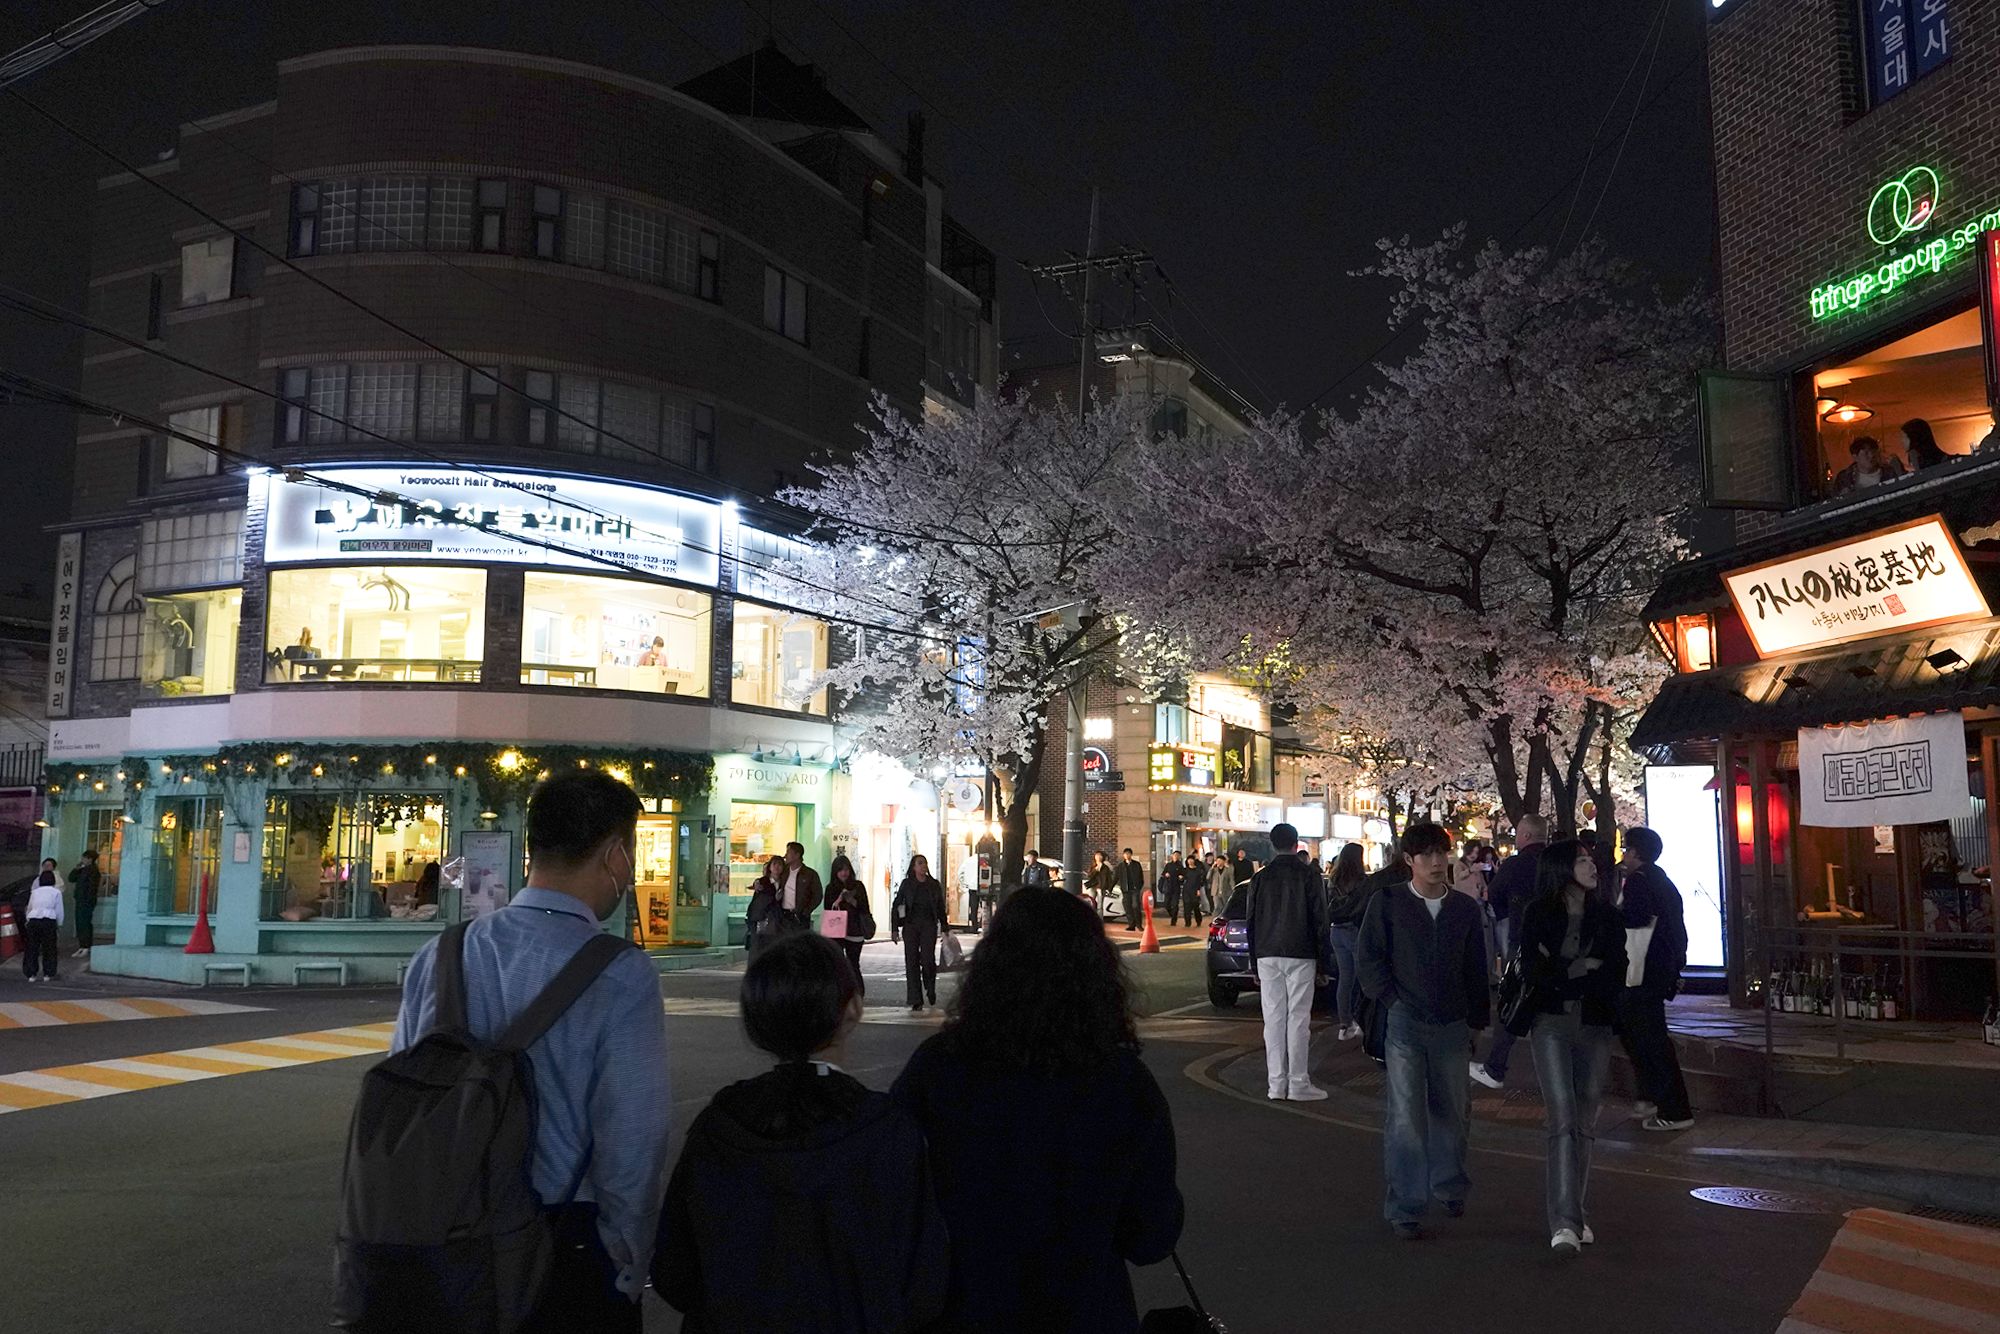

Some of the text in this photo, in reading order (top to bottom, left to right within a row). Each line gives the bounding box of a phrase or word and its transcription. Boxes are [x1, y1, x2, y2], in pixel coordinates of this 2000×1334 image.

[1810, 274, 1873, 318] fringe
[1878, 238, 1947, 293] group
[400, 475, 557, 492] Yeowoozit Hair extensions
[729, 767, 818, 786] 79 FOUNYARD
